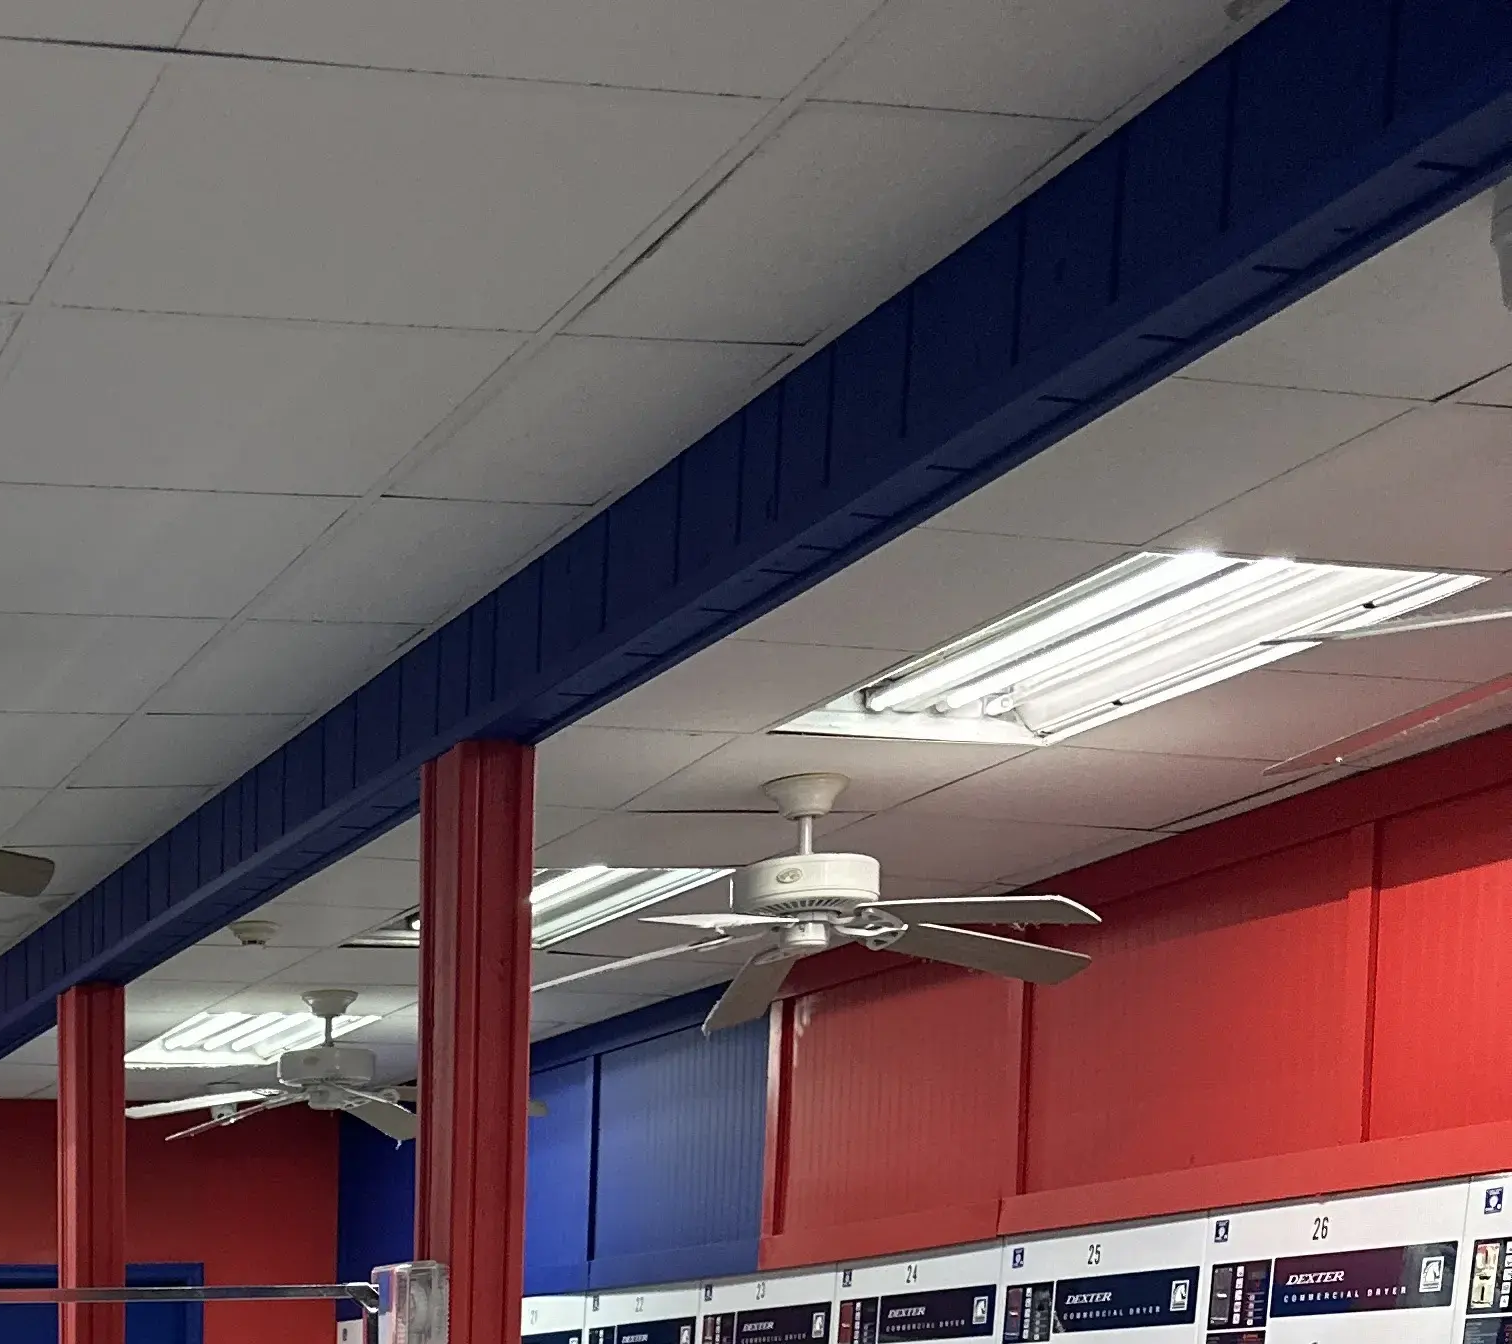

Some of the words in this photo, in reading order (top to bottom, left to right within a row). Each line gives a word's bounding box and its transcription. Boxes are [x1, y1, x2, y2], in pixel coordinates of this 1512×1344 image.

[1312, 1217, 1329, 1241] 26
[1087, 1244, 1101, 1265] 25
[906, 1264, 918, 1284] 24
[1286, 1270, 1345, 1286] DEXTER
[1065, 1291, 1113, 1305] DEXTER
[1283, 1288, 1360, 1304] COMMERCIAL
[1366, 1285, 1407, 1298] DRYER
[888, 1306, 926, 1319] DEXTER
[1063, 1308, 1124, 1321] COMMERCIAL
[1129, 1305, 1161, 1316] DRYER
